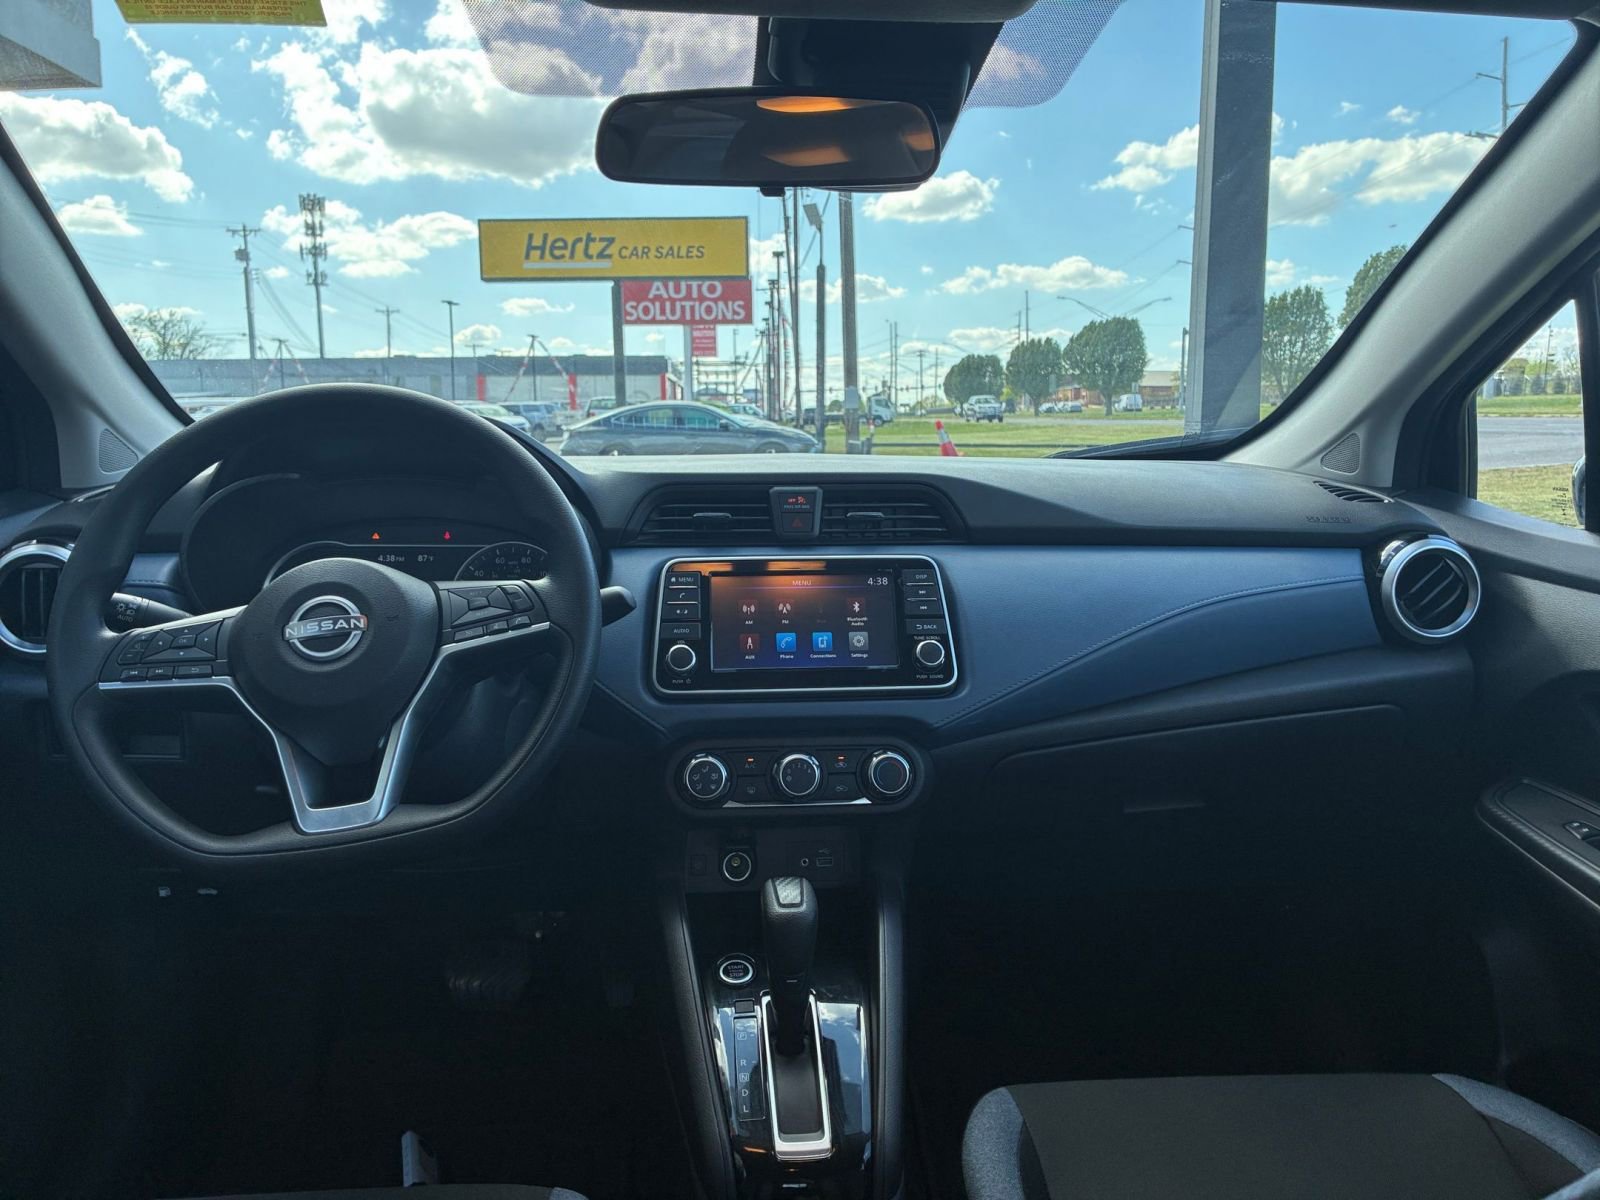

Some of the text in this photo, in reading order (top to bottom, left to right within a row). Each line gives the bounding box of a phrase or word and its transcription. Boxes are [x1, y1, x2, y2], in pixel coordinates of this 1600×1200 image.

[524, 231, 705, 261] Hertz CAR SALES
[648, 280, 722, 299] AUTO
[625, 300, 746, 321] SOLUTIONS
[495, 556, 505, 565] 60
[520, 556, 531, 564] 80
[474, 569, 484, 577] 40
[867, 577, 889, 586] 4:38
[285, 618, 365, 638] NISSAN
[741, 1089, 749, 1097] D
[743, 1105, 749, 1113] L
